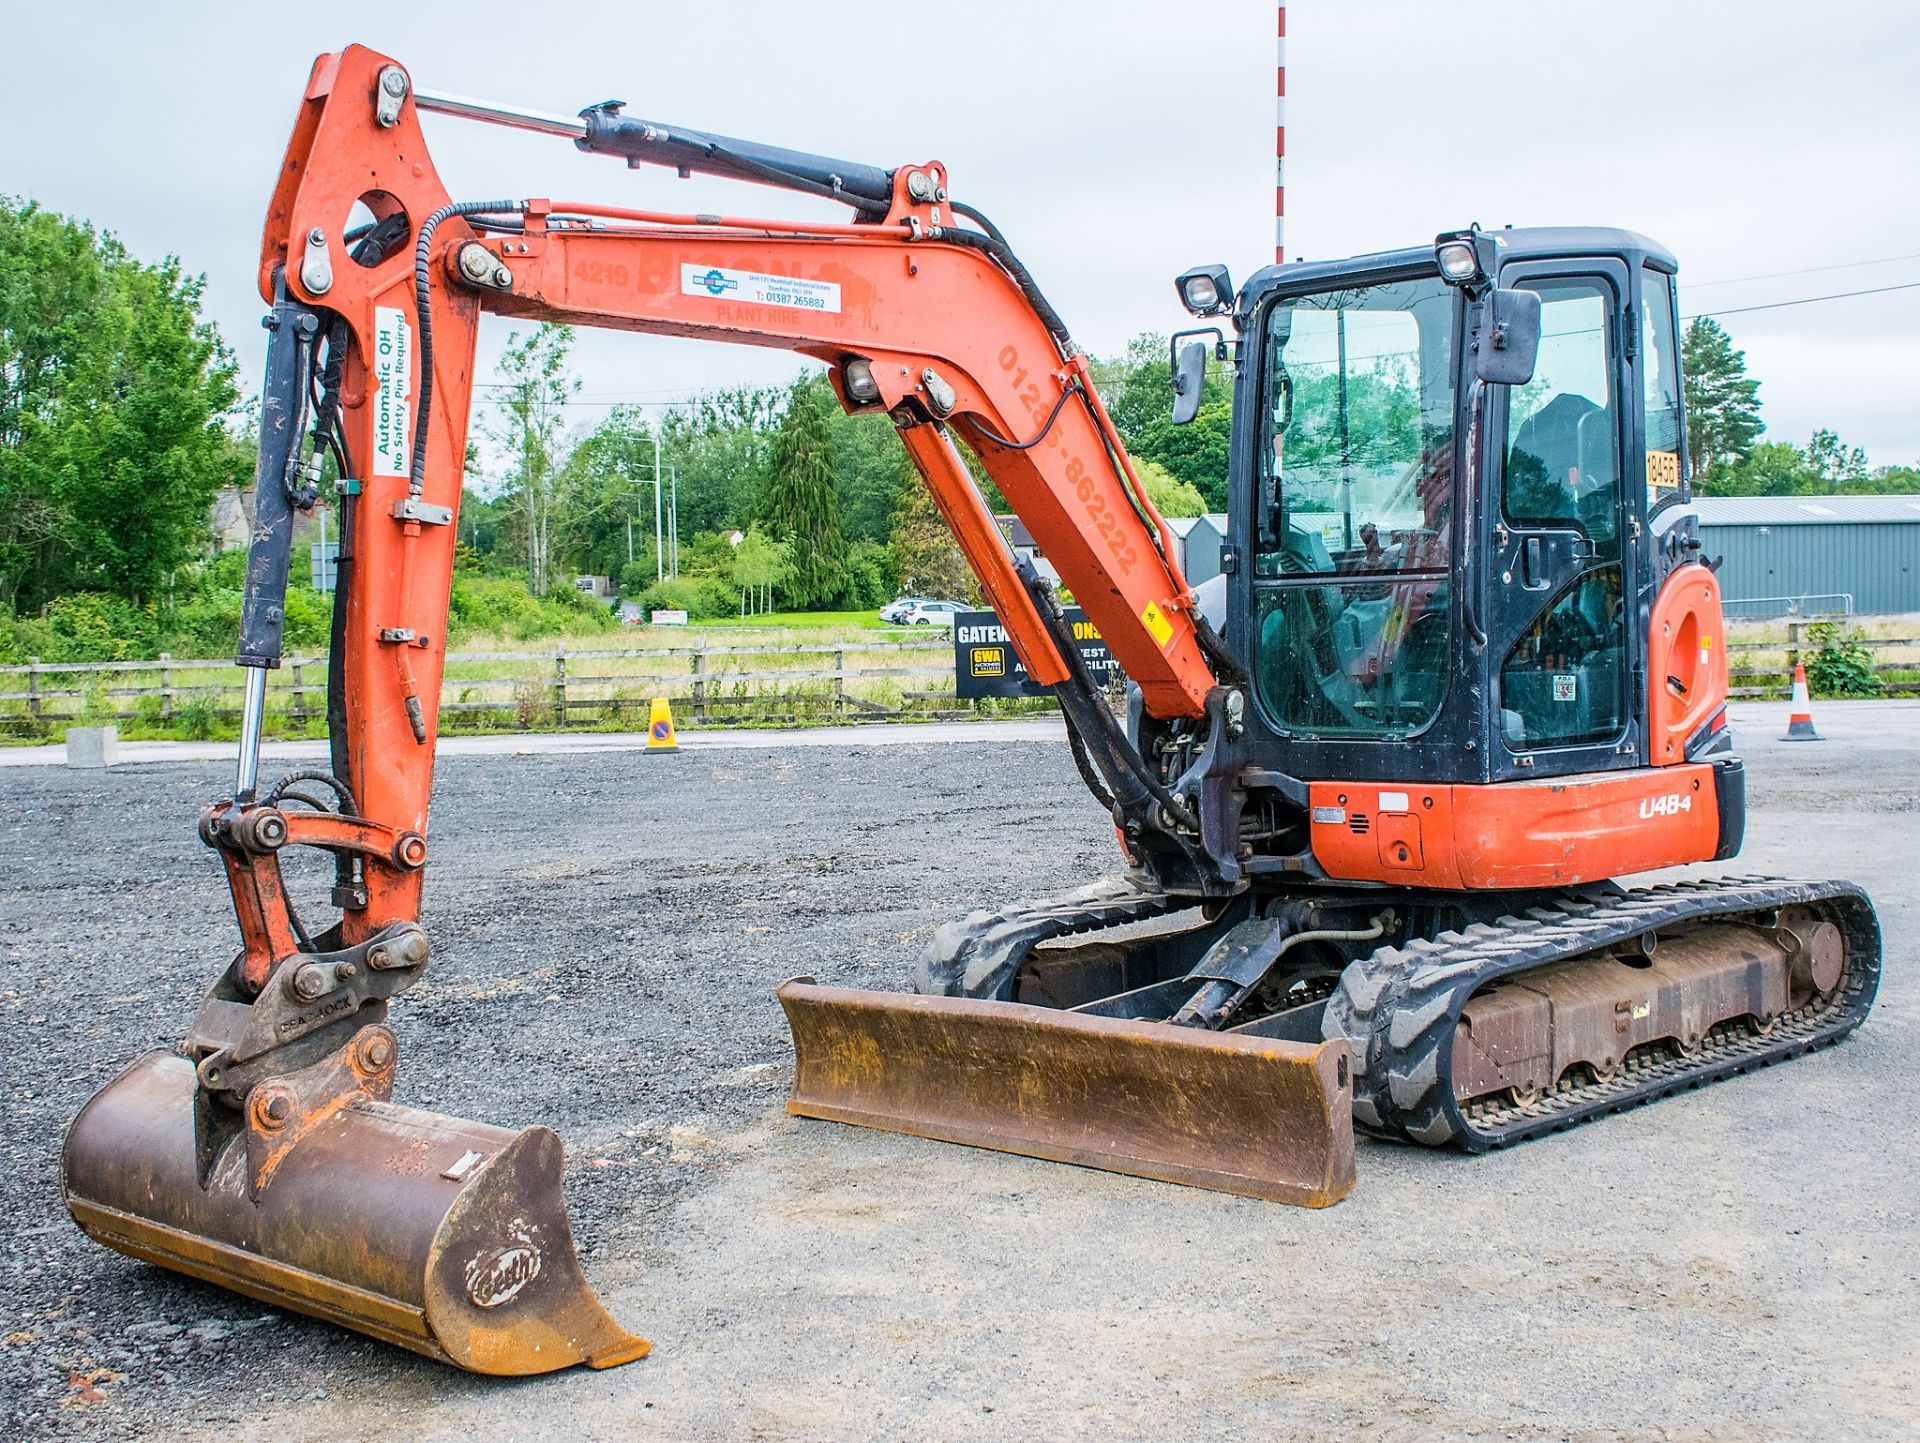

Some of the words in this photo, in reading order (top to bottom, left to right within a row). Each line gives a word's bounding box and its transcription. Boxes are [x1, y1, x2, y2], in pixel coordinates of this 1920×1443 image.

[756, 291, 764, 301] T:
[766, 292, 792, 304] 01387
[793, 295, 825, 308] 265882
[717, 305, 765, 322] PLANT
[768, 311, 800, 325] HIRE
[379, 329, 393, 356] QH
[395, 314, 406, 374] Required
[395, 379, 404, 401] Pin
[378, 362, 392, 456] Automatic
[394, 405, 406, 446] Safety
[394, 451, 404, 471] No
[1647, 455, 1676, 484] 18456
[973, 649, 1001, 663] GWA
[1080, 647, 1106, 658] EST
[1639, 793, 1692, 819] U48-4
